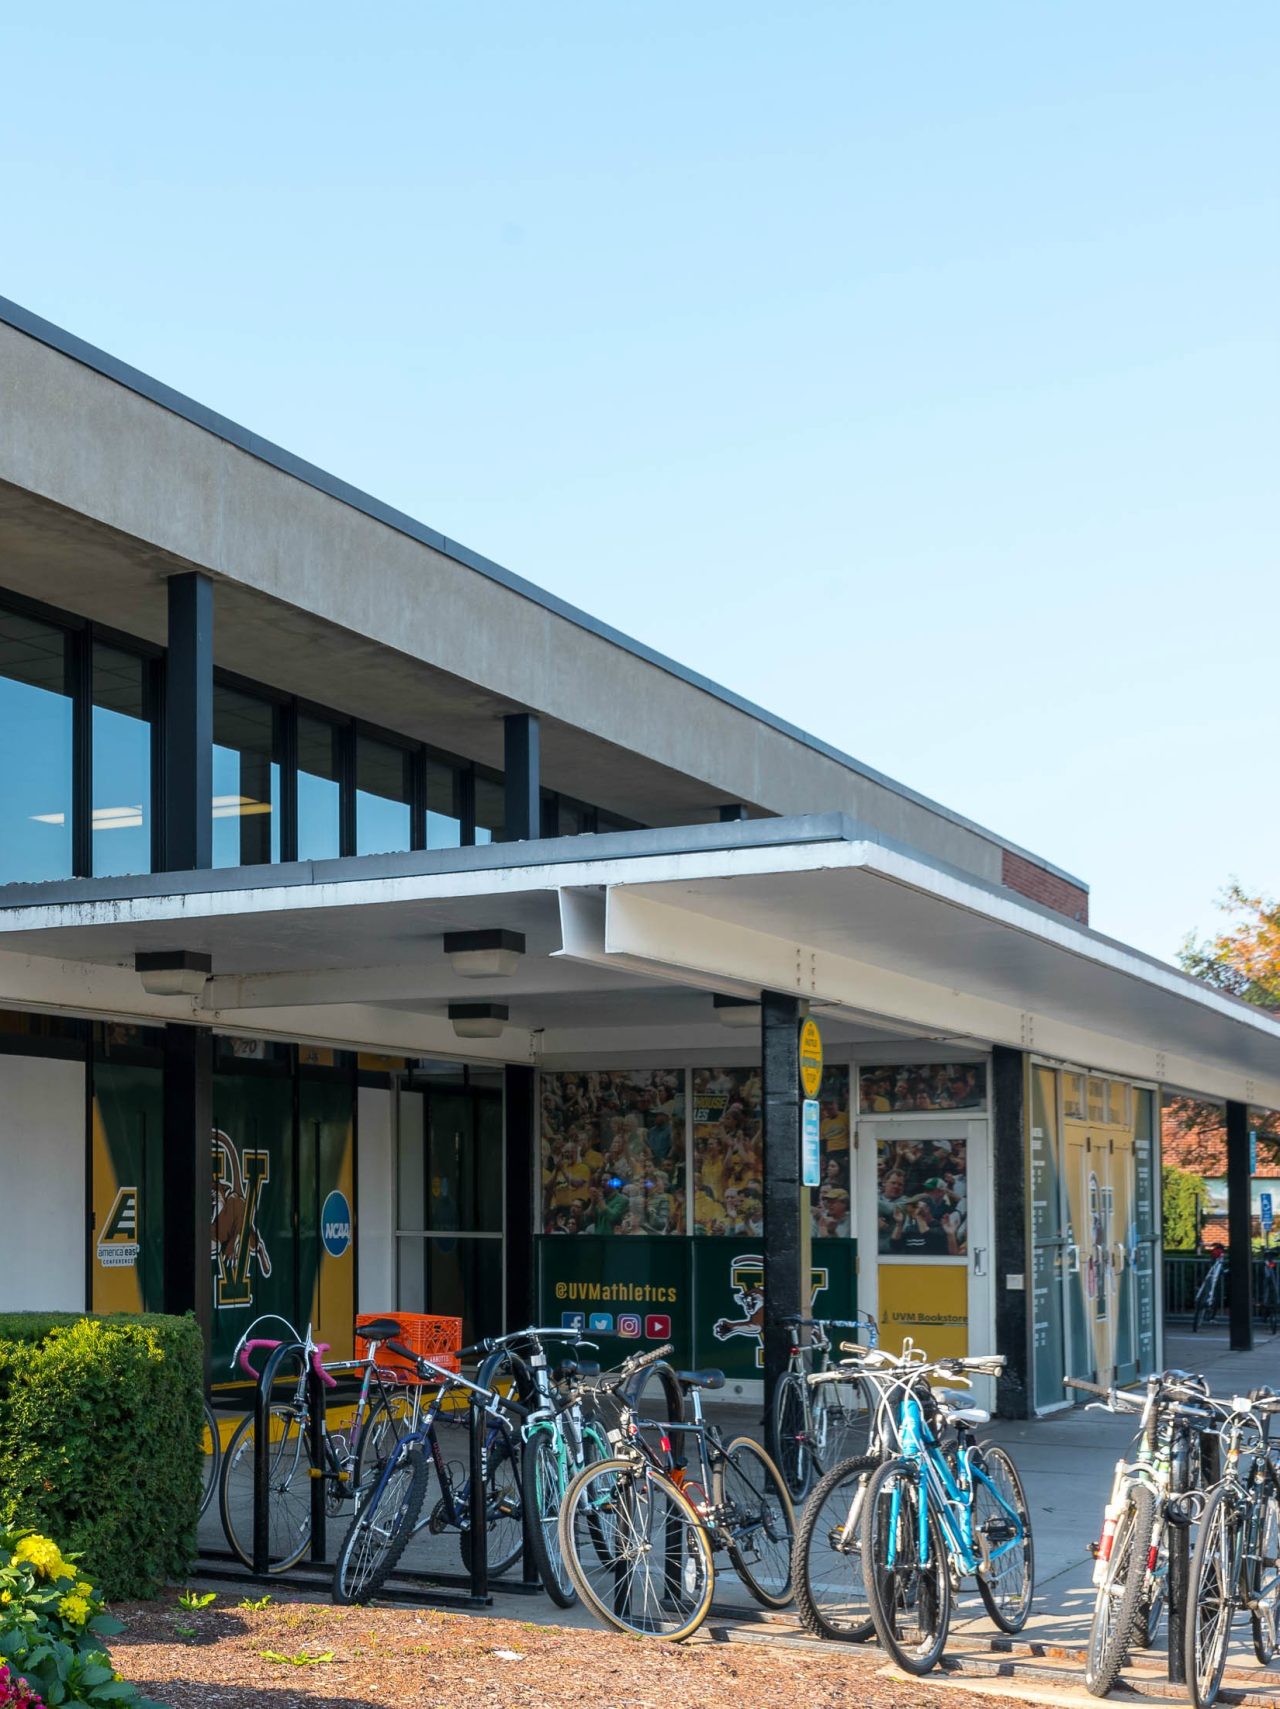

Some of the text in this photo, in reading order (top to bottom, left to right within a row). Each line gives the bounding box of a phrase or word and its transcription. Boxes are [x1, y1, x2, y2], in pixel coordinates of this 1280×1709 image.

[325, 1222, 350, 1239] NCAA
[555, 1282, 677, 1302] @UVMathletics
[892, 1311, 968, 1322] UVM Bookstore
